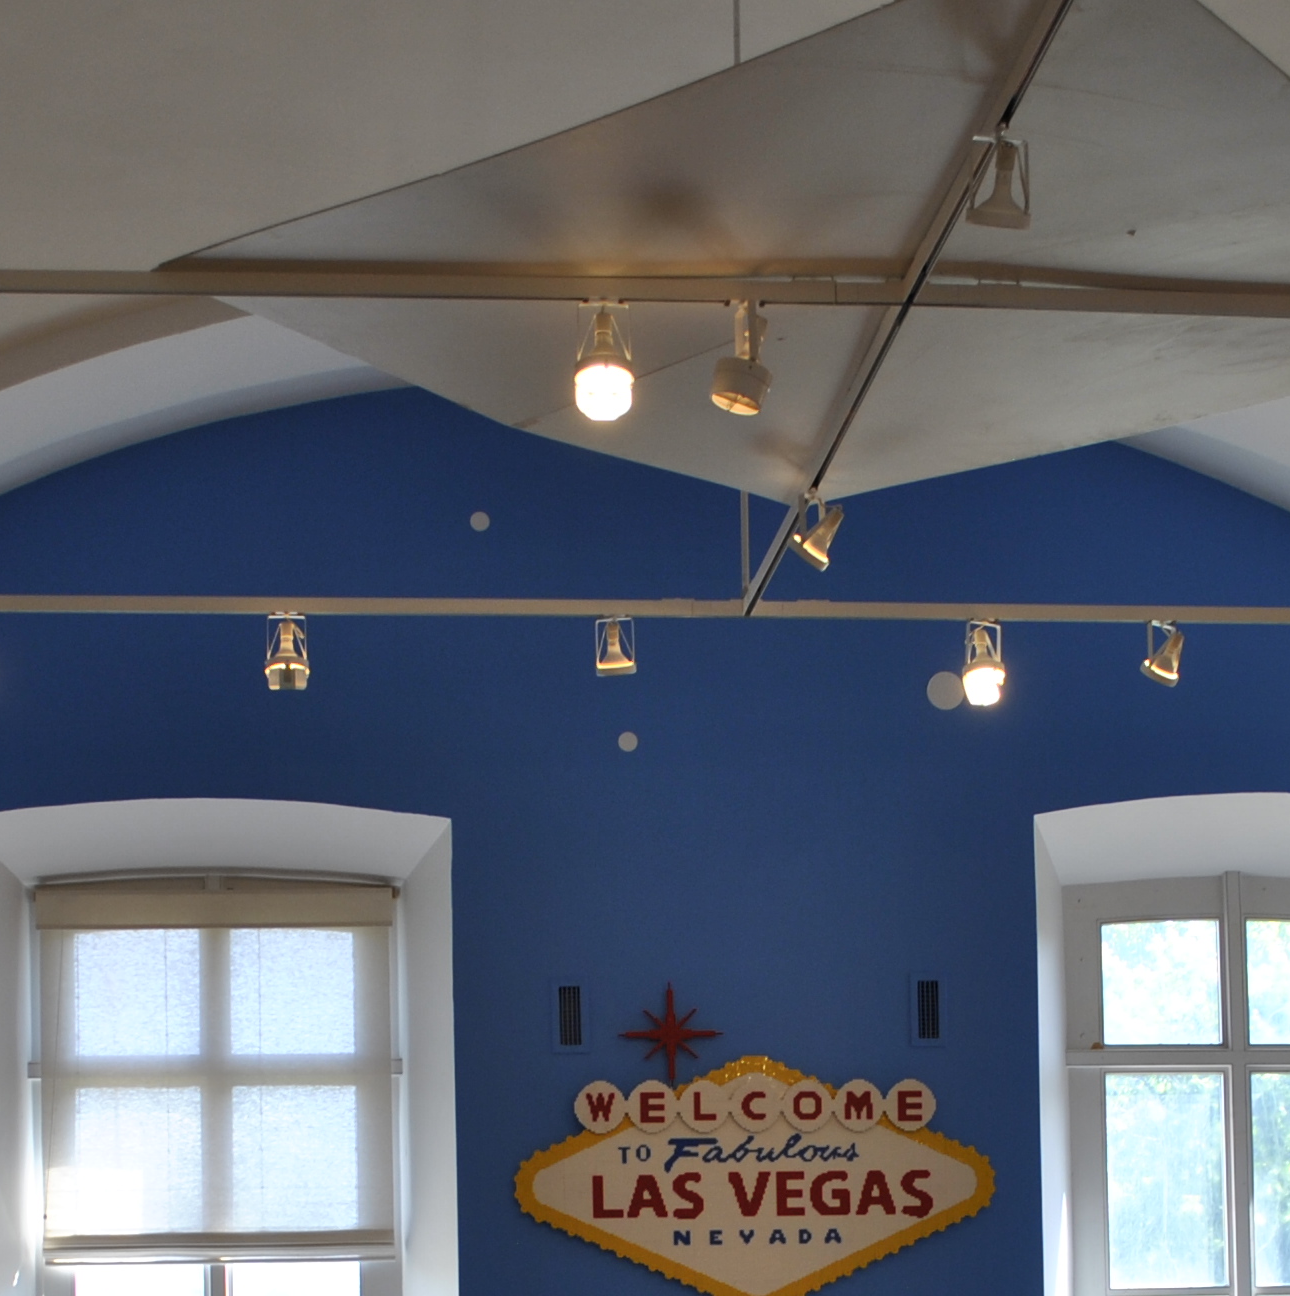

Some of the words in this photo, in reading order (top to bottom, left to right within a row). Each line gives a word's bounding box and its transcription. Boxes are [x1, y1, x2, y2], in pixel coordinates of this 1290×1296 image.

[586, 1090, 922, 1123] WELCOME
[618, 1145, 651, 1164] TO
[664, 1133, 859, 1172] Fabulous
[592, 1172, 704, 1219] LAS
[728, 1169, 934, 1219] VEGAS
[673, 1228, 842, 1246] NEVADA
